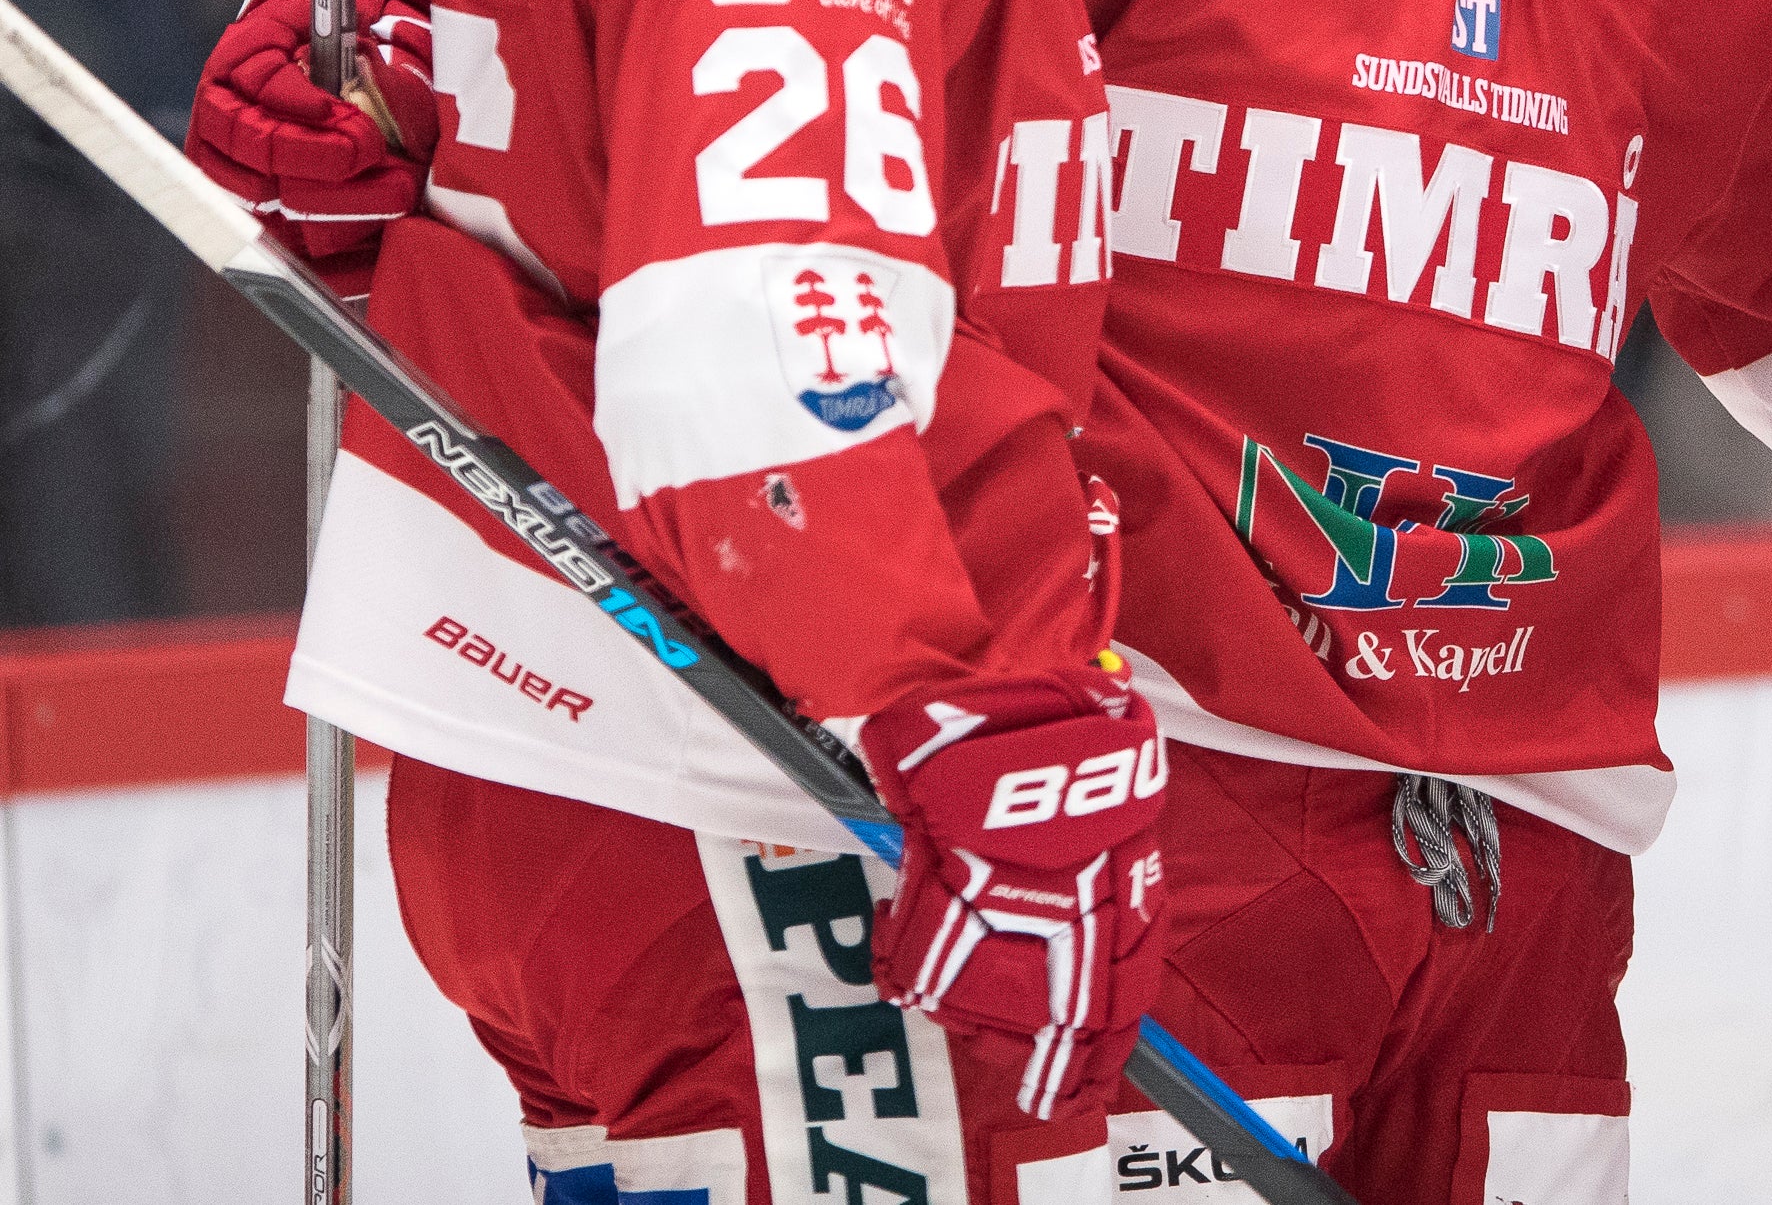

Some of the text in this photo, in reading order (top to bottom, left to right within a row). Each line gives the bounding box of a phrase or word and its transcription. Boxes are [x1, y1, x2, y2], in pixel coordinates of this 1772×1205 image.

[692, 25, 937, 238] 26
[1351, 52, 1569, 136] SUNDSVALLS TIDNING
[406, 421, 613, 596] NEXUS
[423, 615, 594, 724] BAUER
[1344, 630, 1396, 681] &
[1401, 625, 1535, 693] Kapell
[983, 737, 1170, 830] BAU
